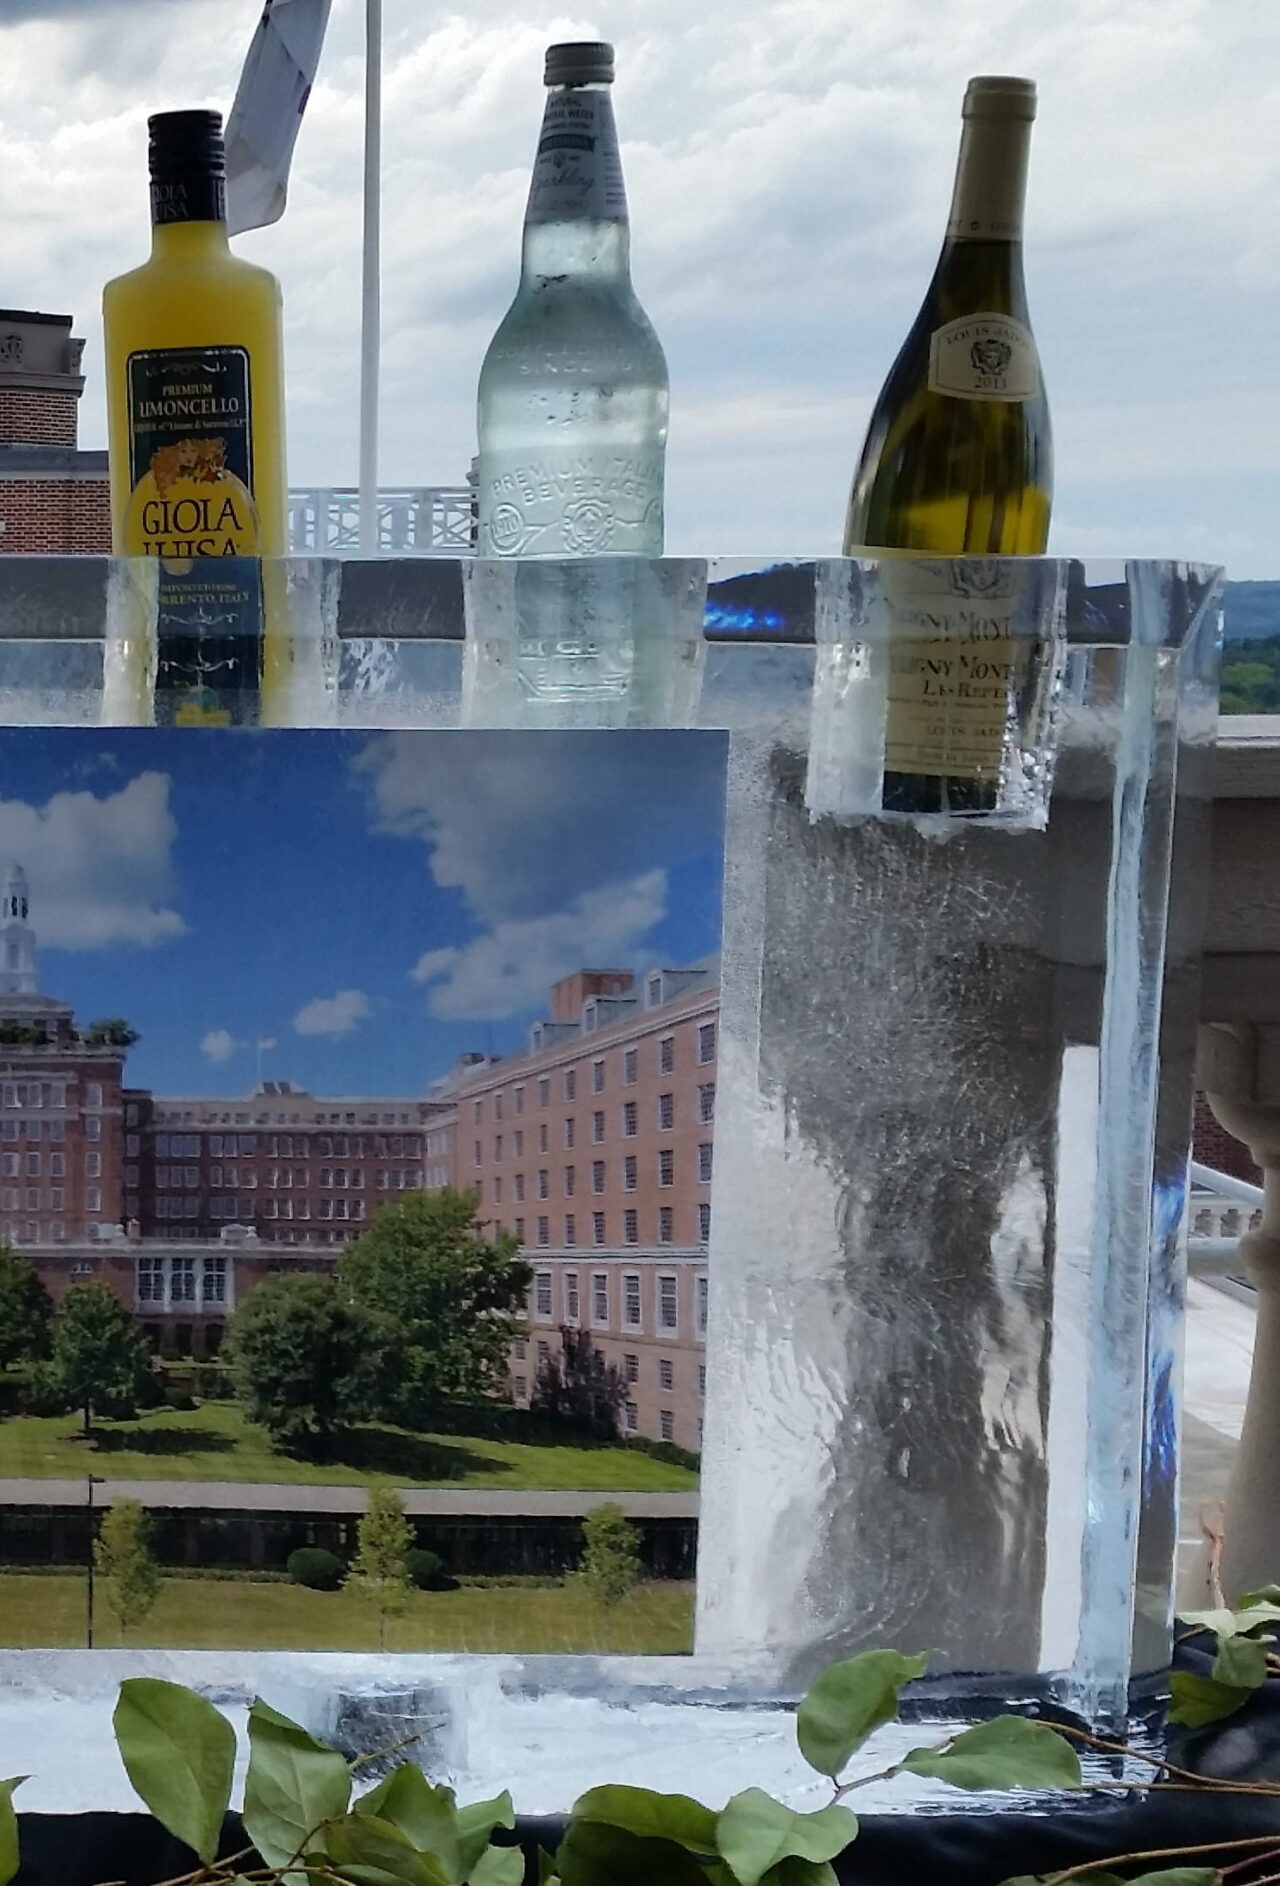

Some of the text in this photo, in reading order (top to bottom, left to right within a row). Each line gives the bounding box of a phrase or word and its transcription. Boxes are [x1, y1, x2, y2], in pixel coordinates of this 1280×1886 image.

[162, 383, 213, 397] PREMIUM
[139, 397, 240, 418] LIMONCELLO
[524, 476, 647, 505] BEVERAGE
[141, 497, 243, 535] GIOIA
